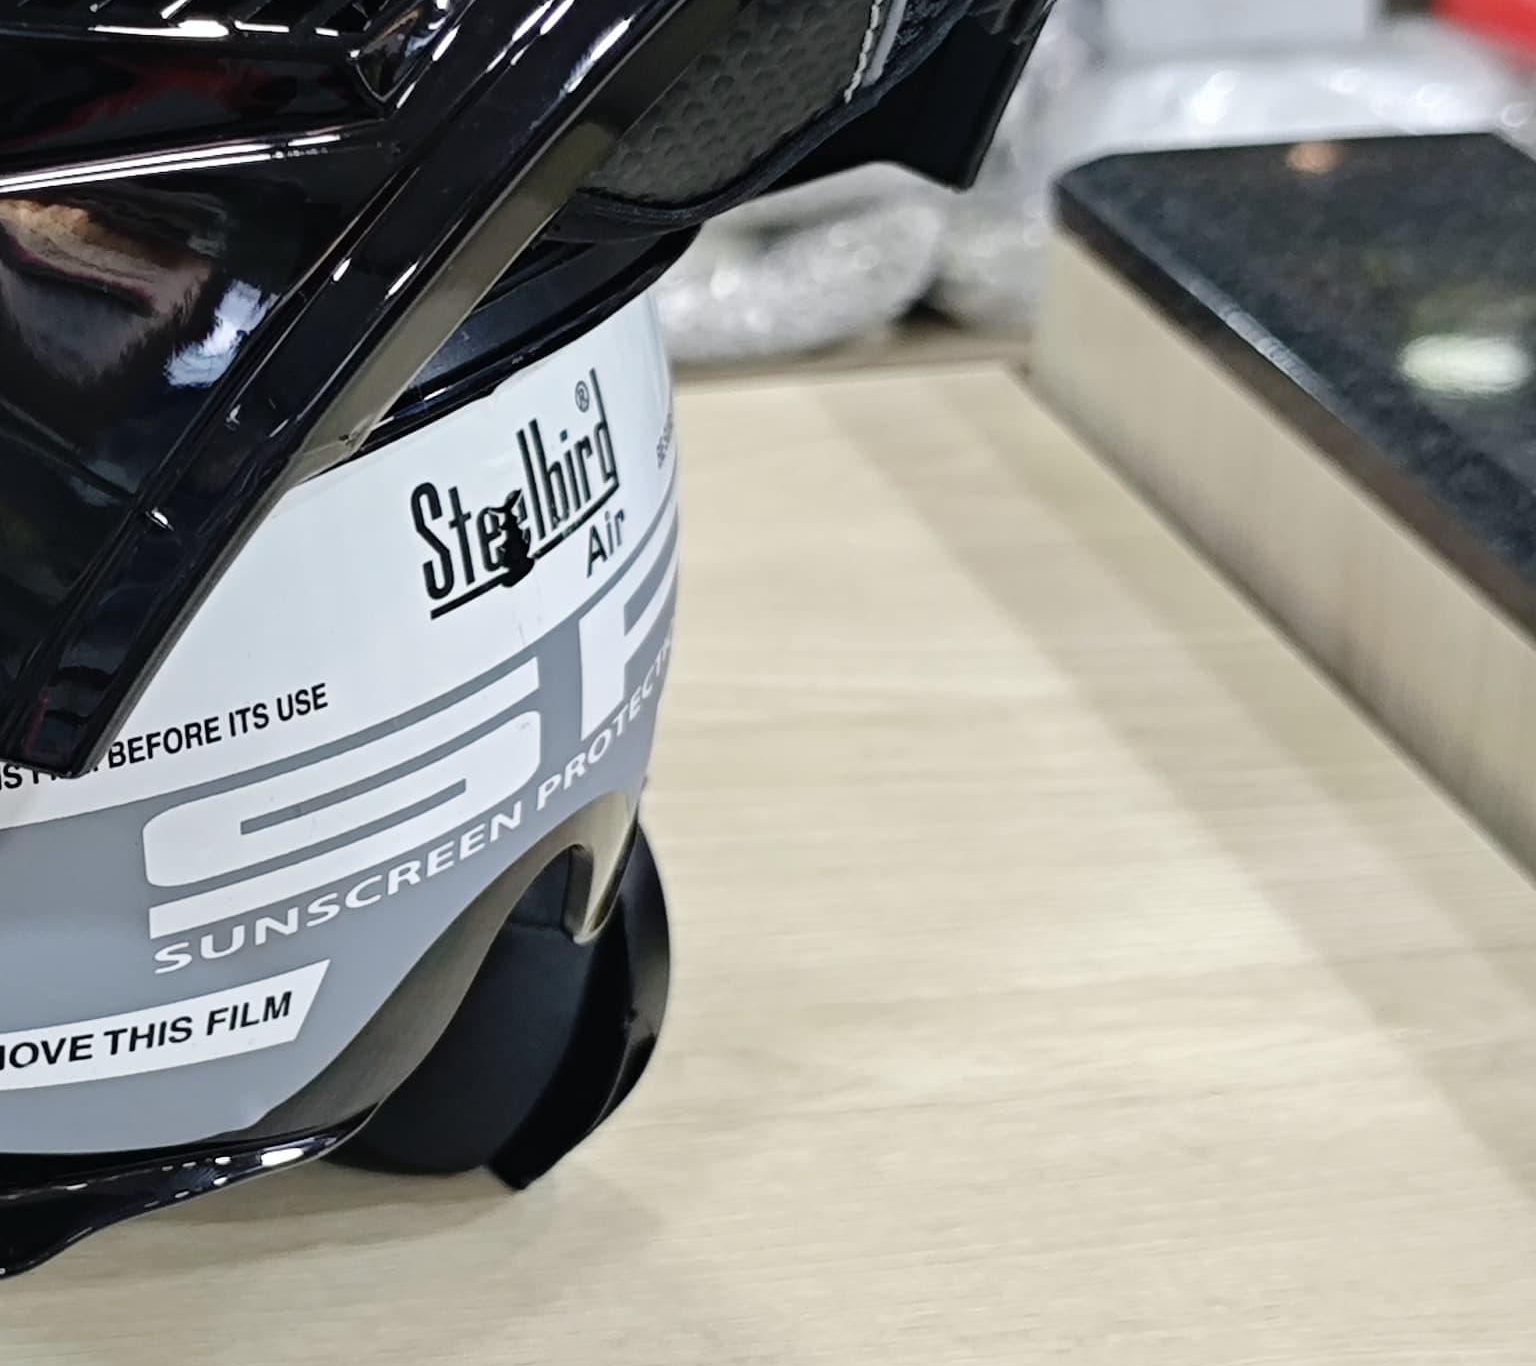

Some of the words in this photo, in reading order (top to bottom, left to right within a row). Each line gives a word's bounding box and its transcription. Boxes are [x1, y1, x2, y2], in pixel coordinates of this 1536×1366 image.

[586, 508, 625, 578] Air
[108, 716, 222, 769] BEFORE
[228, 702, 270, 737] ITS
[276, 682, 329, 722] USE
[153, 800, 523, 976] SUNSCREEN
[104, 1015, 193, 1056] THIS
[206, 990, 294, 1036] FILM
